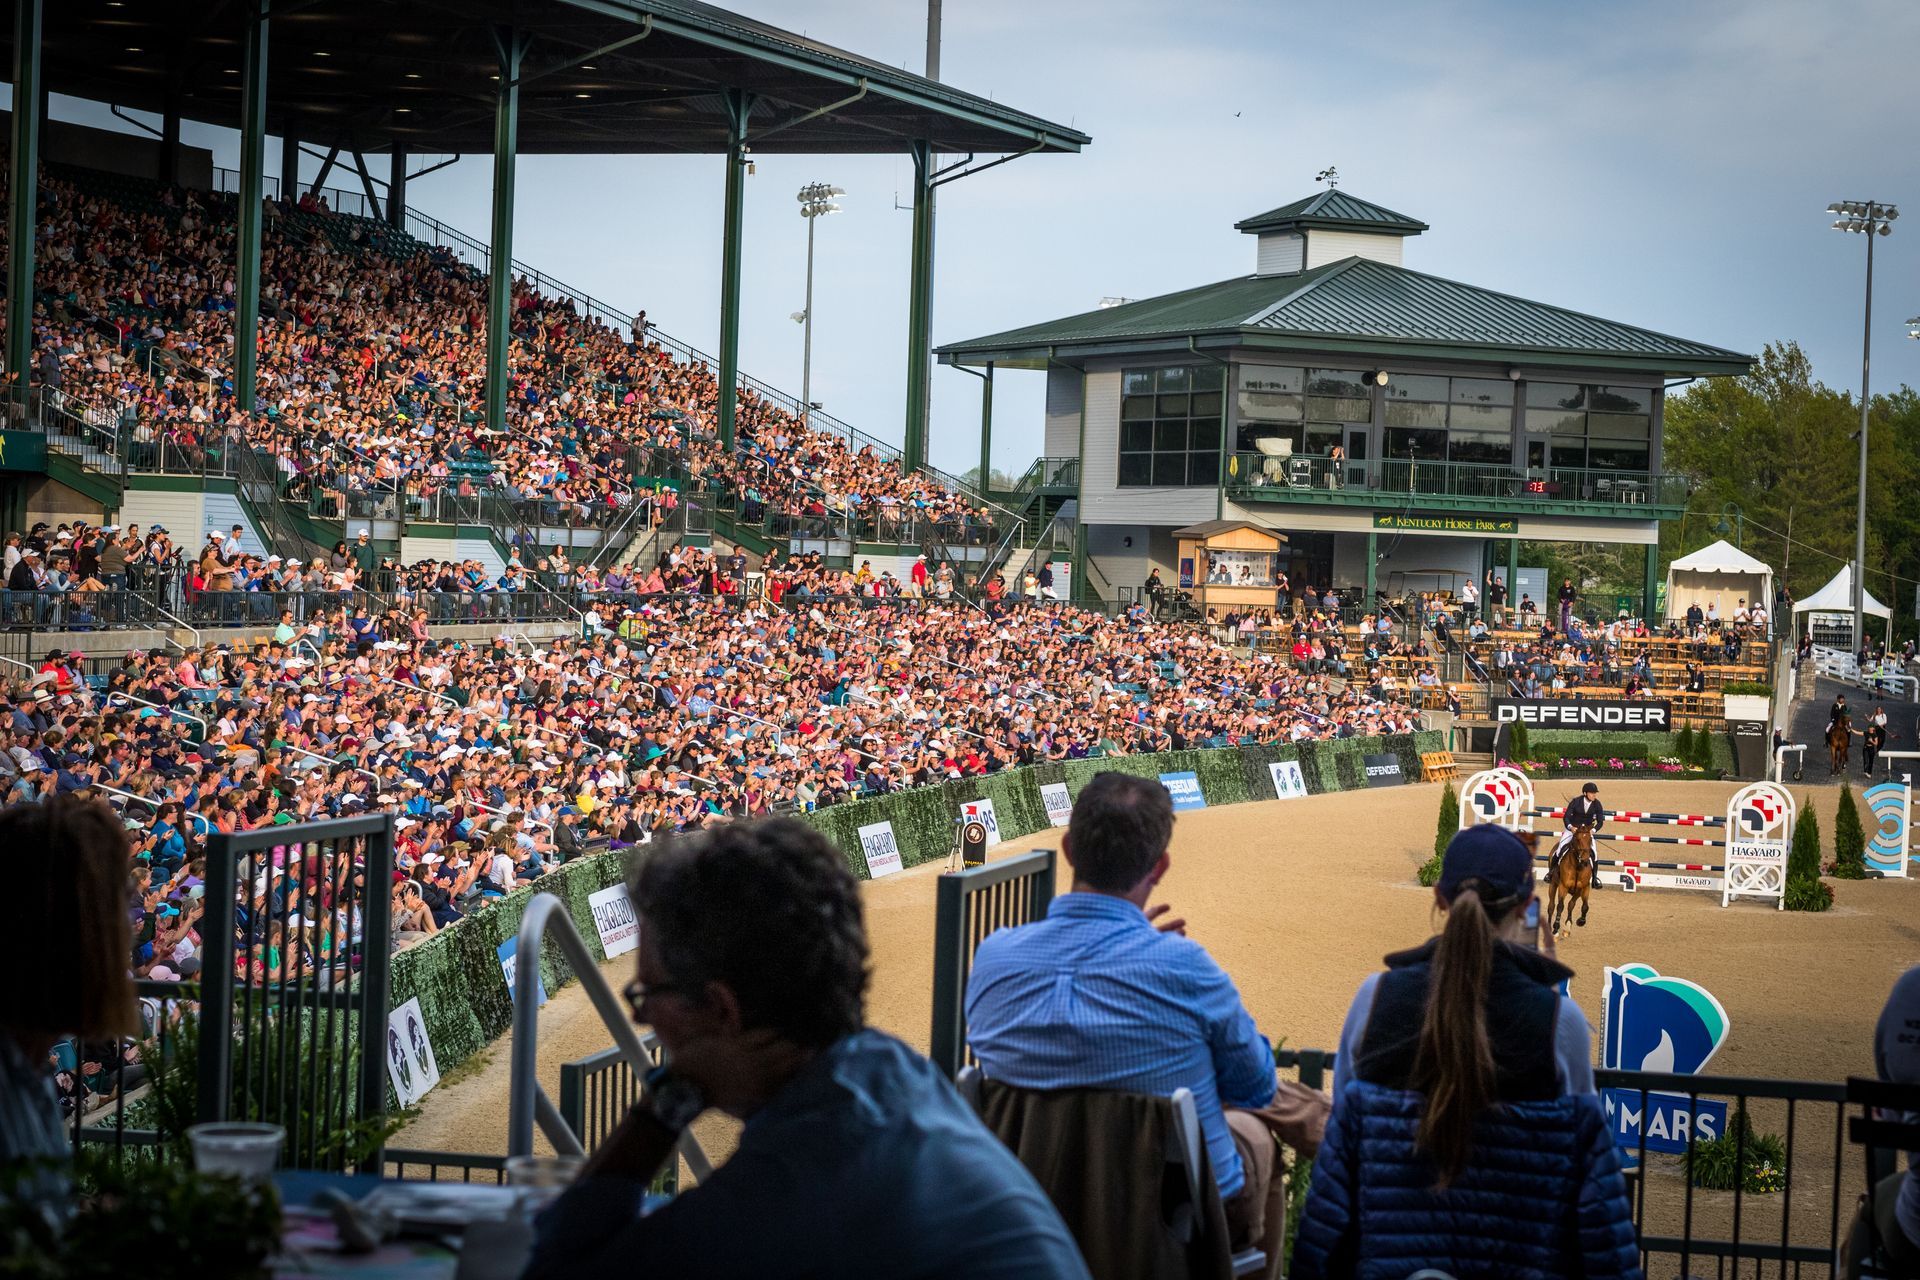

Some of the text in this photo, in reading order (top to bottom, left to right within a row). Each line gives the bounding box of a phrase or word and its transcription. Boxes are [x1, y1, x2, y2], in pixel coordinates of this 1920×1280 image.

[1396, 515, 1496, 531] KENTUCKY HORSE PARK
[1498, 705, 1666, 724] DEFENDER
[1365, 764, 1400, 776] DEFENDER
[1731, 846, 1781, 858] HAGYARD
[1675, 877, 1711, 886] HAGYARD
[593, 897, 634, 933] HAGYARD
[1620, 1102, 1717, 1143] MARS
